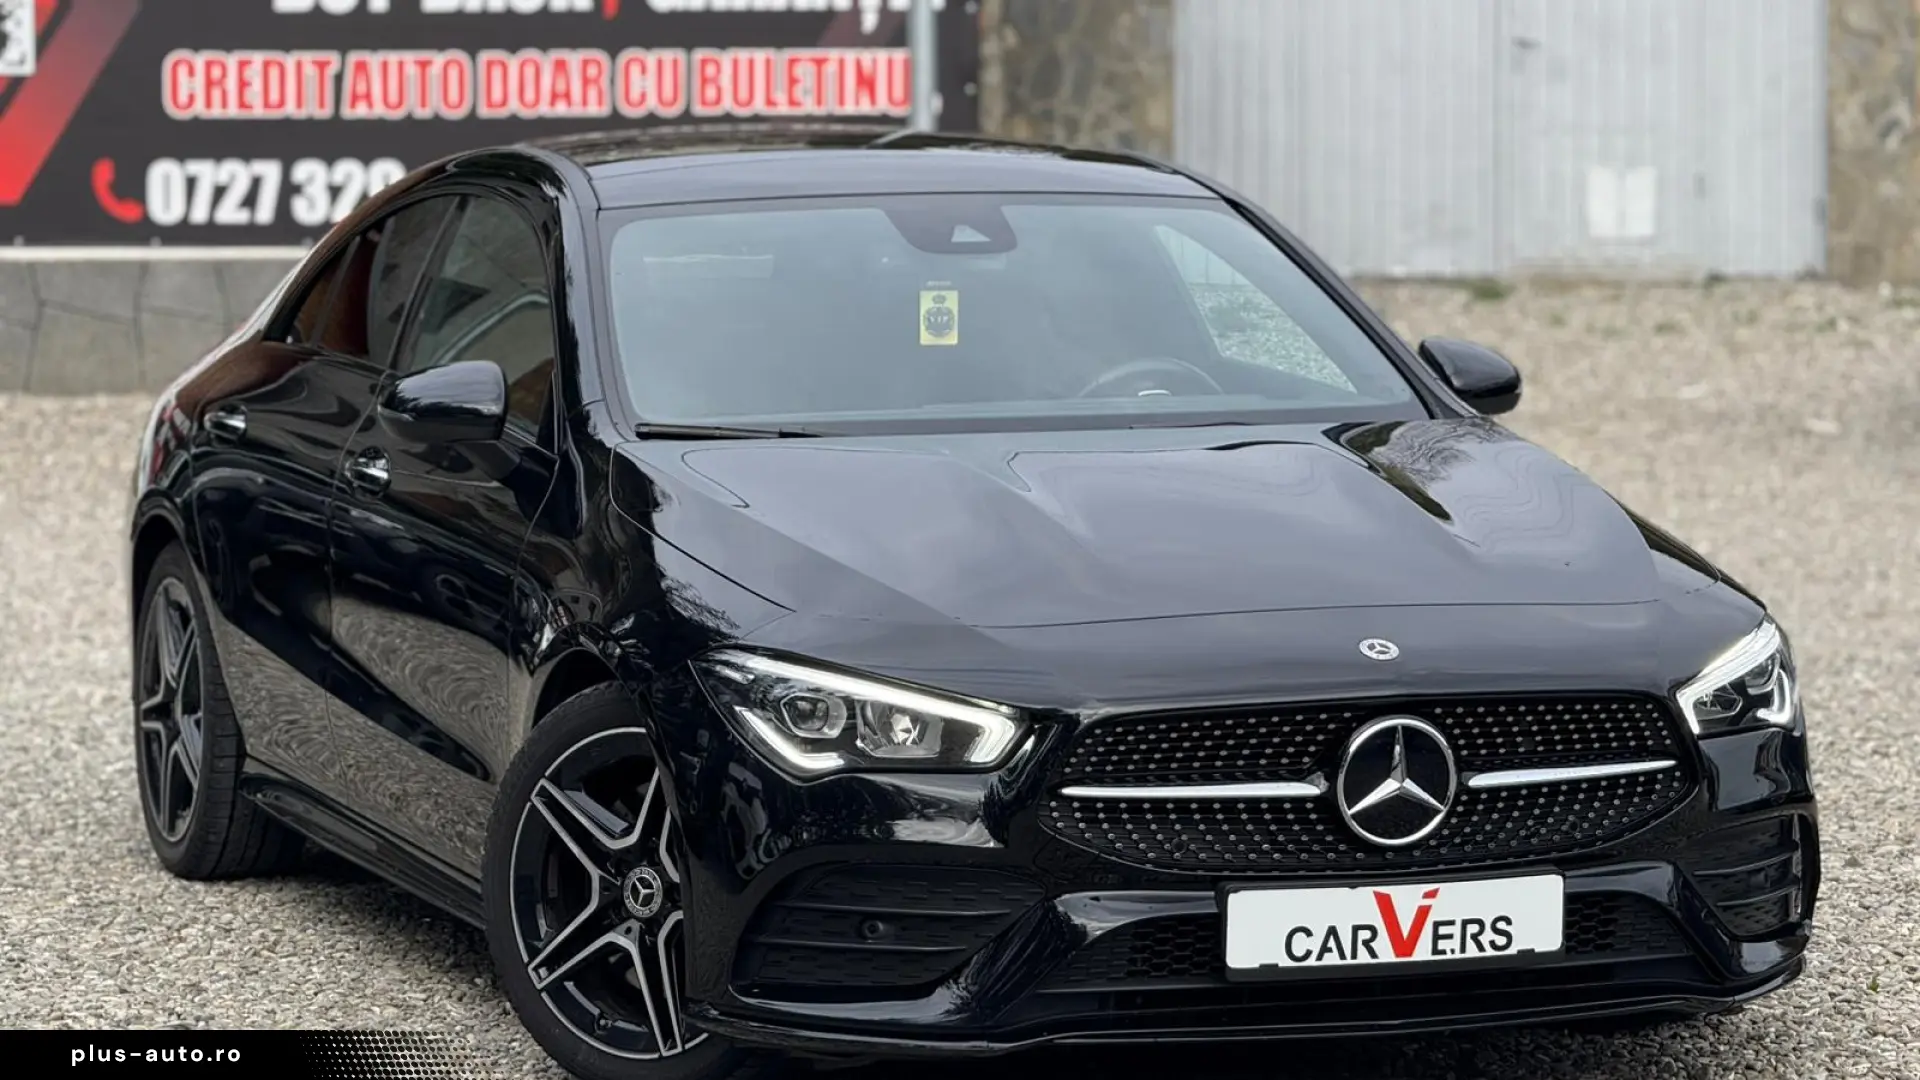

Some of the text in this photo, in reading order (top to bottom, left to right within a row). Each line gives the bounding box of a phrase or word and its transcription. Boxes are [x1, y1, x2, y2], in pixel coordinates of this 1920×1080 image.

[165, 48, 943, 118] CREDIT AUTO DOAR CU BULETINU
[145, 157, 282, 226] 0727
